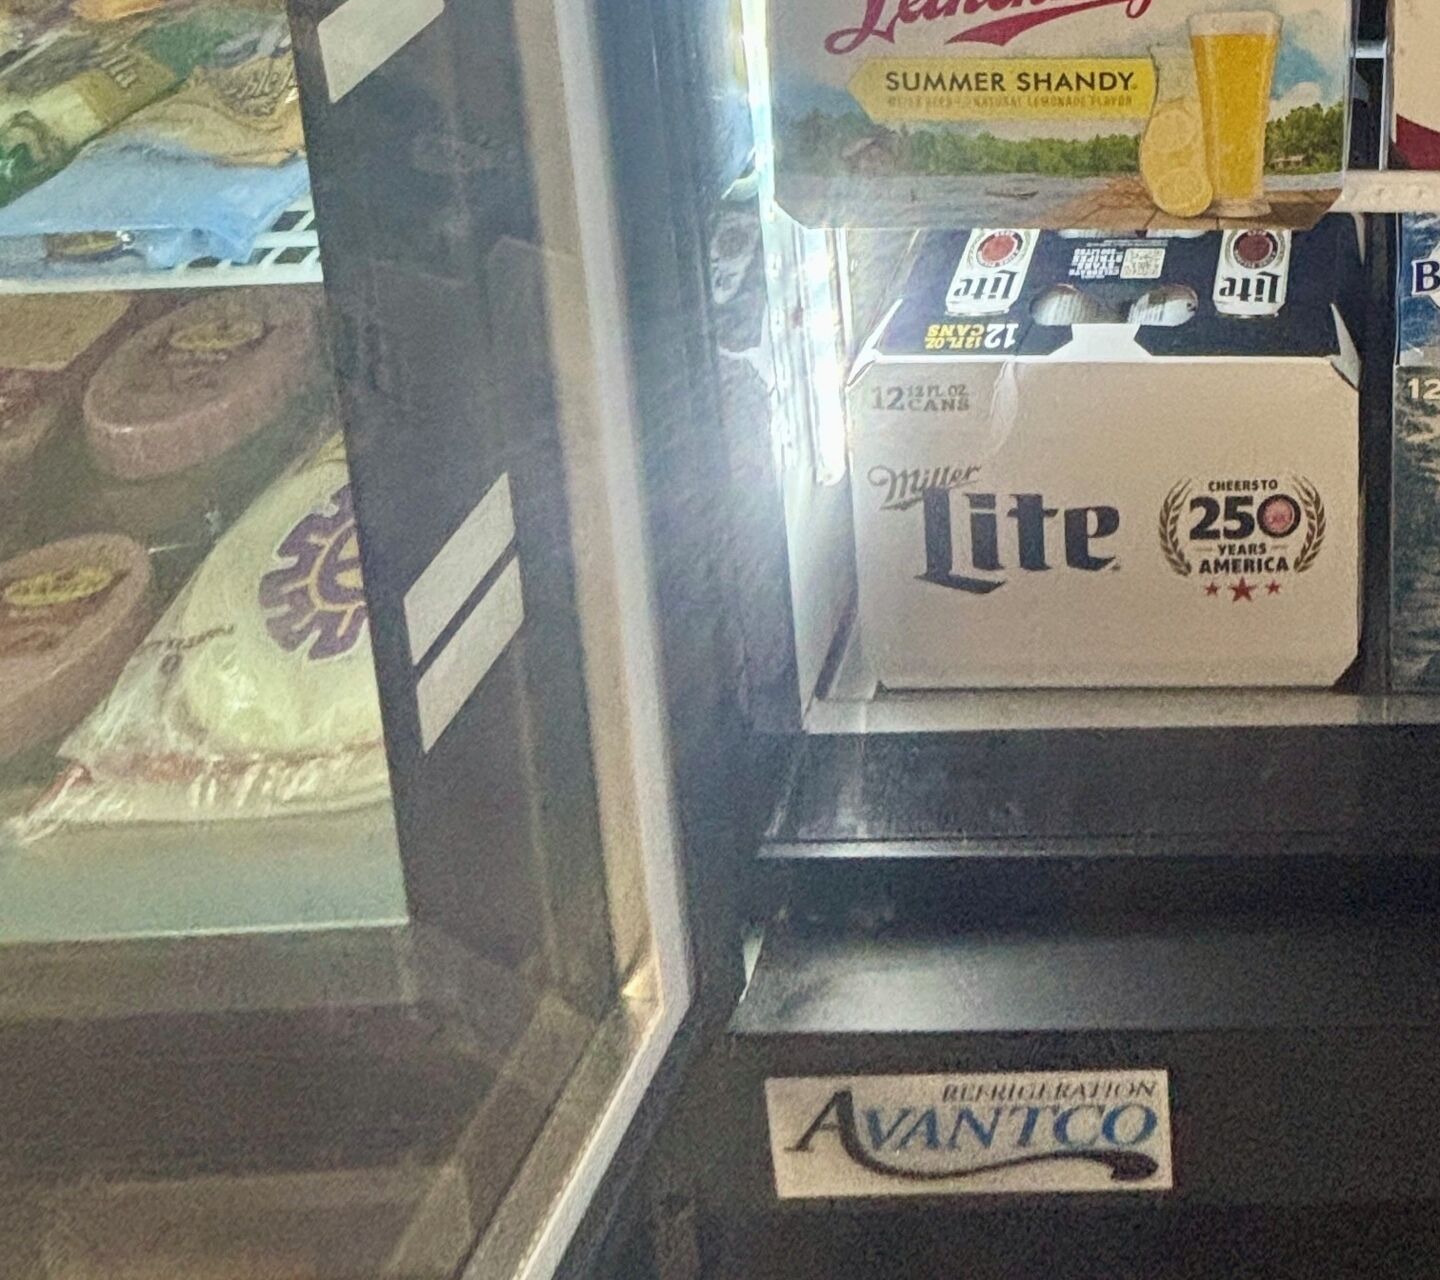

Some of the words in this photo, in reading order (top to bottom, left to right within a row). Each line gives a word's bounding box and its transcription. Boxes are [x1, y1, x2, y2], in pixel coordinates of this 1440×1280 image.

[886, 71, 1005, 91] SUMMER
[1017, 71, 1135, 91] SHANDY
[953, 271, 1018, 301] Lite
[1219, 271, 1282, 305] Lite
[926, 324, 984, 337] CANS
[871, 385, 906, 411] 12
[908, 384, 925, 397] 12
[948, 383, 970, 397] OZ
[907, 398, 970, 412] CANS
[868, 464, 982, 511] Miller
[1208, 480, 1254, 492] CHEERS
[1257, 479, 1278, 491] TO
[1189, 493, 1302, 540] 250
[915, 487, 1121, 594] Lite
[1217, 543, 1268, 557] YEARS
[1198, 556, 1290, 574] AMERICA
[942, 1081, 1157, 1103] REFRIGERATION
[783, 1087, 1160, 1168] AVANTCO
